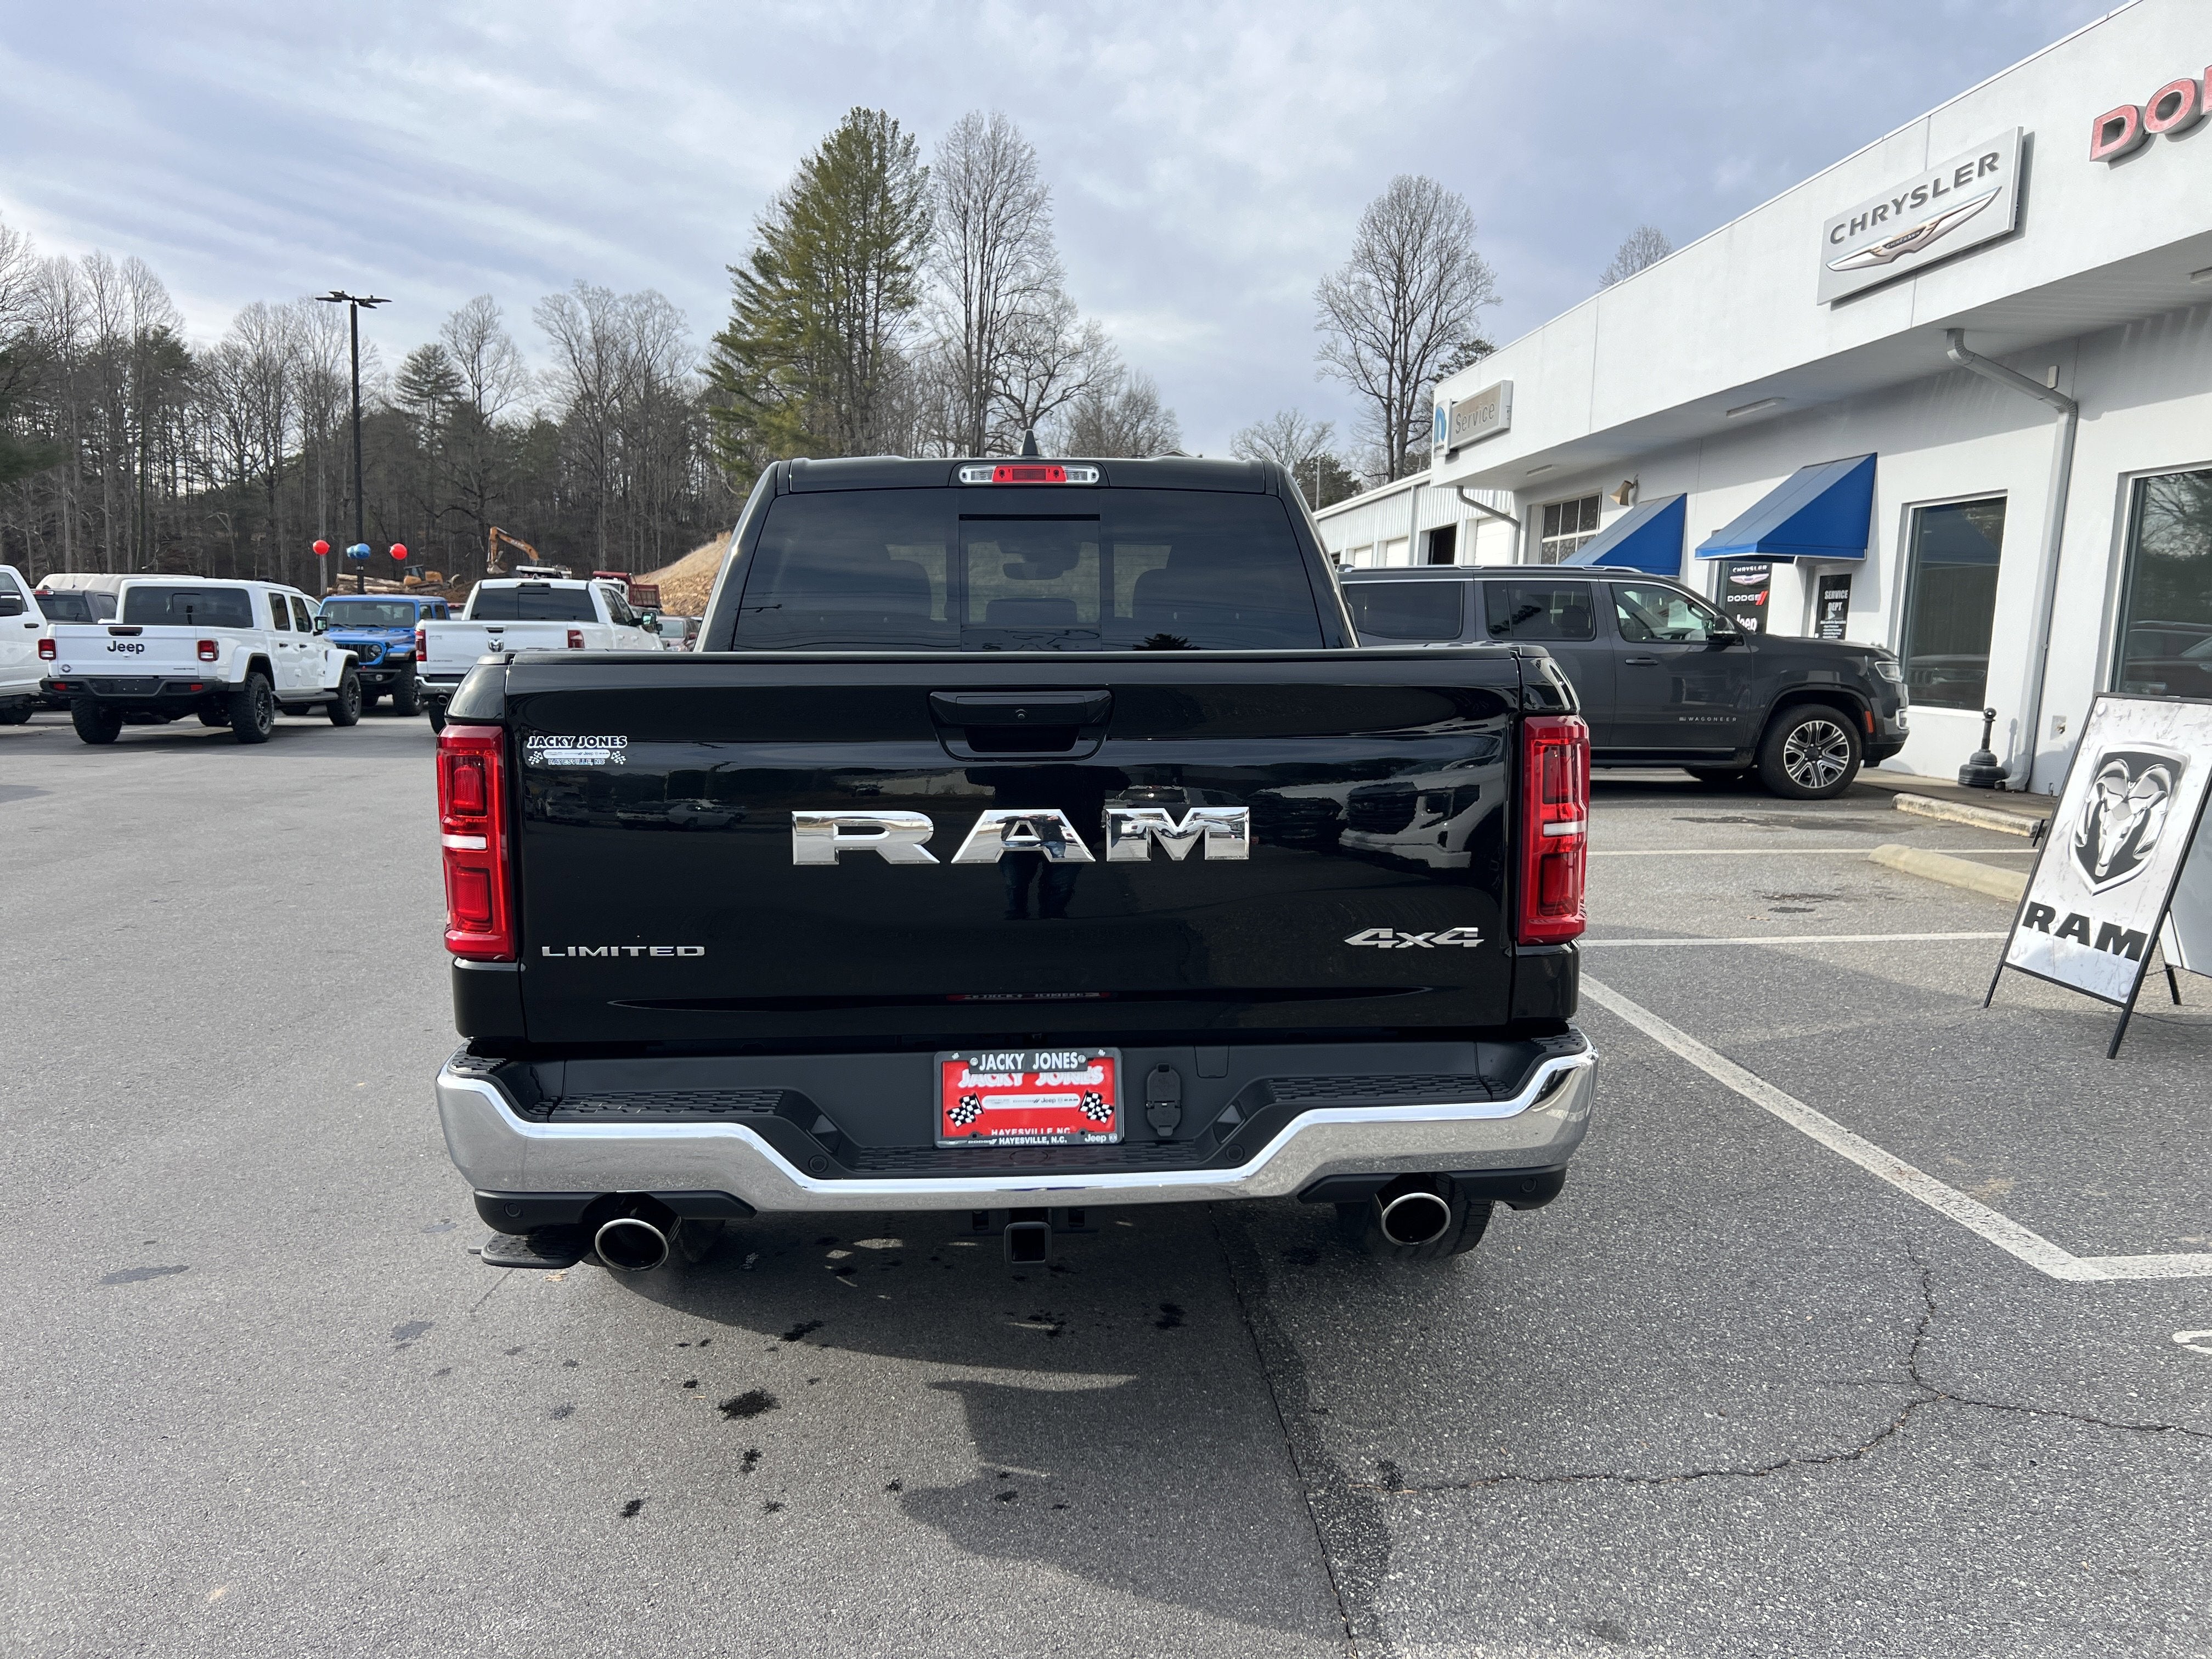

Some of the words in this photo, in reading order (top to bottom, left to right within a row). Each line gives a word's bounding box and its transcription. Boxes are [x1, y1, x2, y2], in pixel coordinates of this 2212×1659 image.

[2090, 64, 2212, 162] DO
[1830, 151, 2000, 245] CHRYSLER
[1455, 402, 1495, 434] Service
[1733, 565, 1767, 573] CHRYSLER
[1727, 594, 1761, 602] DODGE
[1824, 589, 1848, 600] SERVICE
[1827, 601, 1842, 611] DEPT
[107, 640, 145, 654] Jeep
[527, 736, 575, 748] JACKY
[577, 736, 628, 748] JONES
[791, 805, 1251, 866] RAM
[1344, 927, 1485, 948] 4x4
[2021, 900, 2148, 962] RAM
[541, 946, 705, 957] LIMITED
[979, 1053, 1025, 1071] JACKY
[1032, 1052, 1079, 1069] JONES
[957, 1069, 1024, 1088] JACKY
[1035, 1065, 1104, 1087] JONES
[998, 1136, 1049, 1145] HAYESVILLE,
[1084, 1133, 1107, 1143] Jeep
